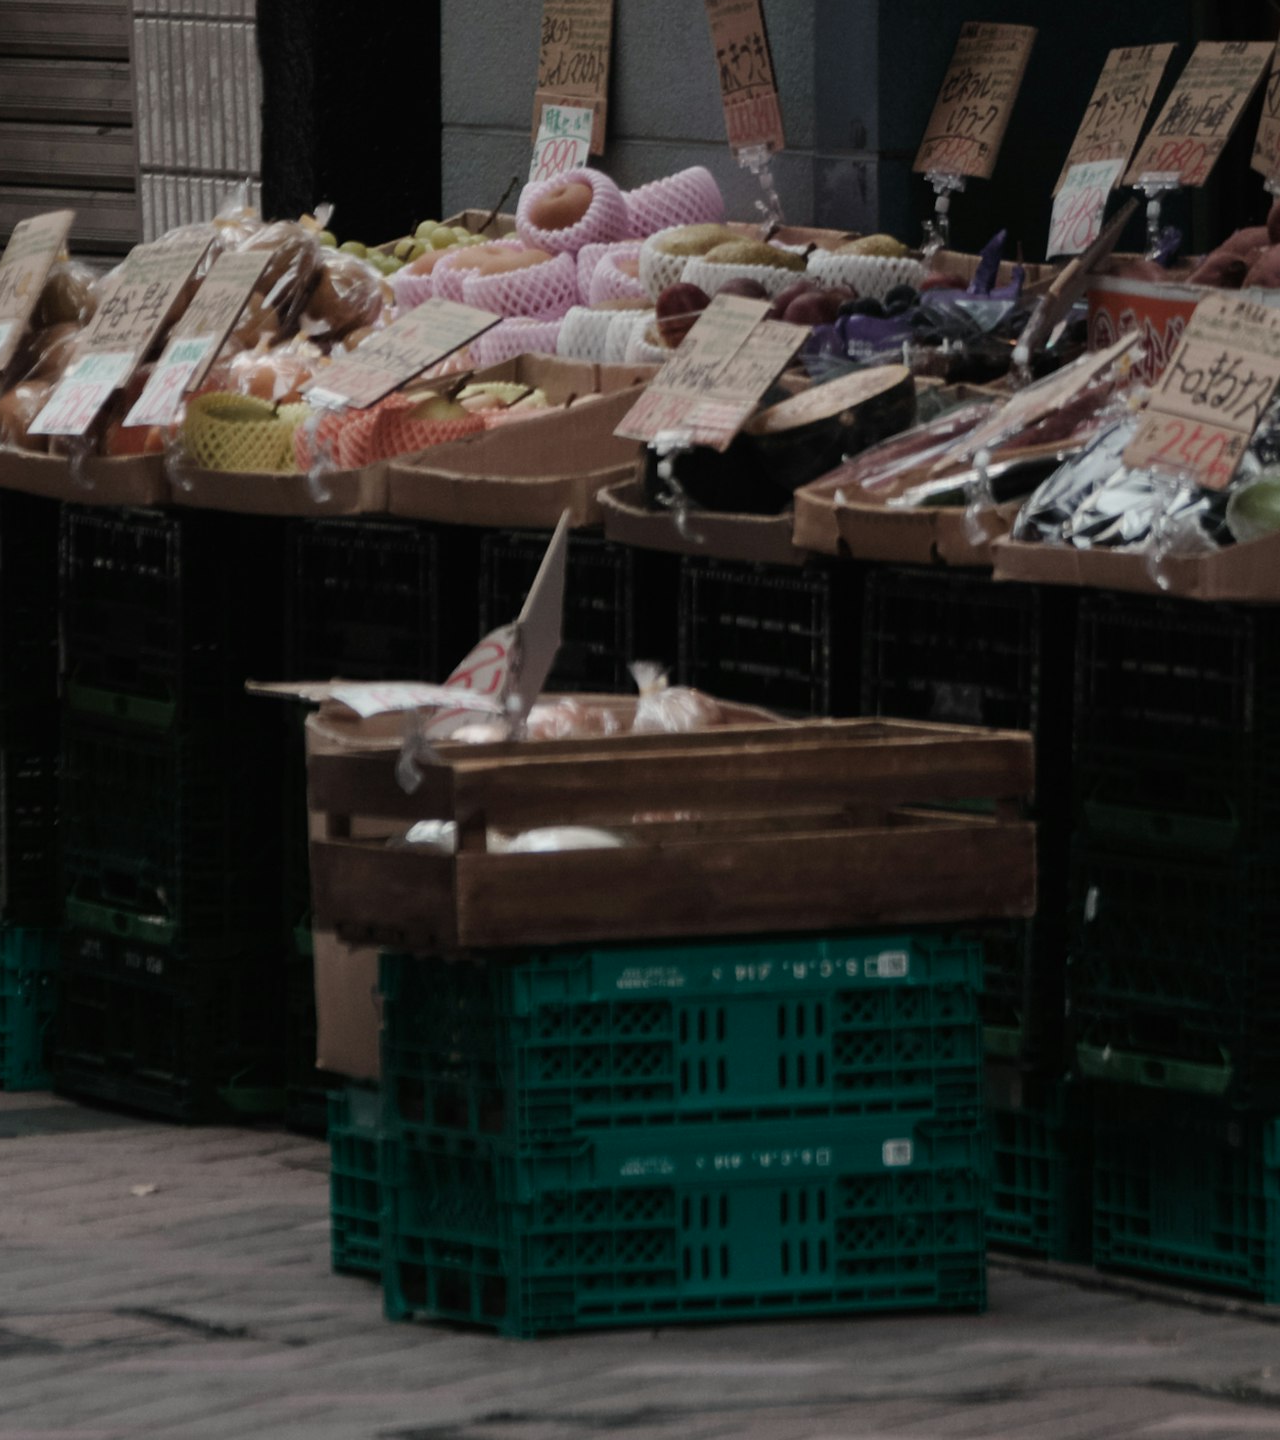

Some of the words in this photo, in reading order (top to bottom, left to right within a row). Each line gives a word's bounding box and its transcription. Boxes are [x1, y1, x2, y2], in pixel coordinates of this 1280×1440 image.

[1161, 341, 1274, 420] トロまるナス
